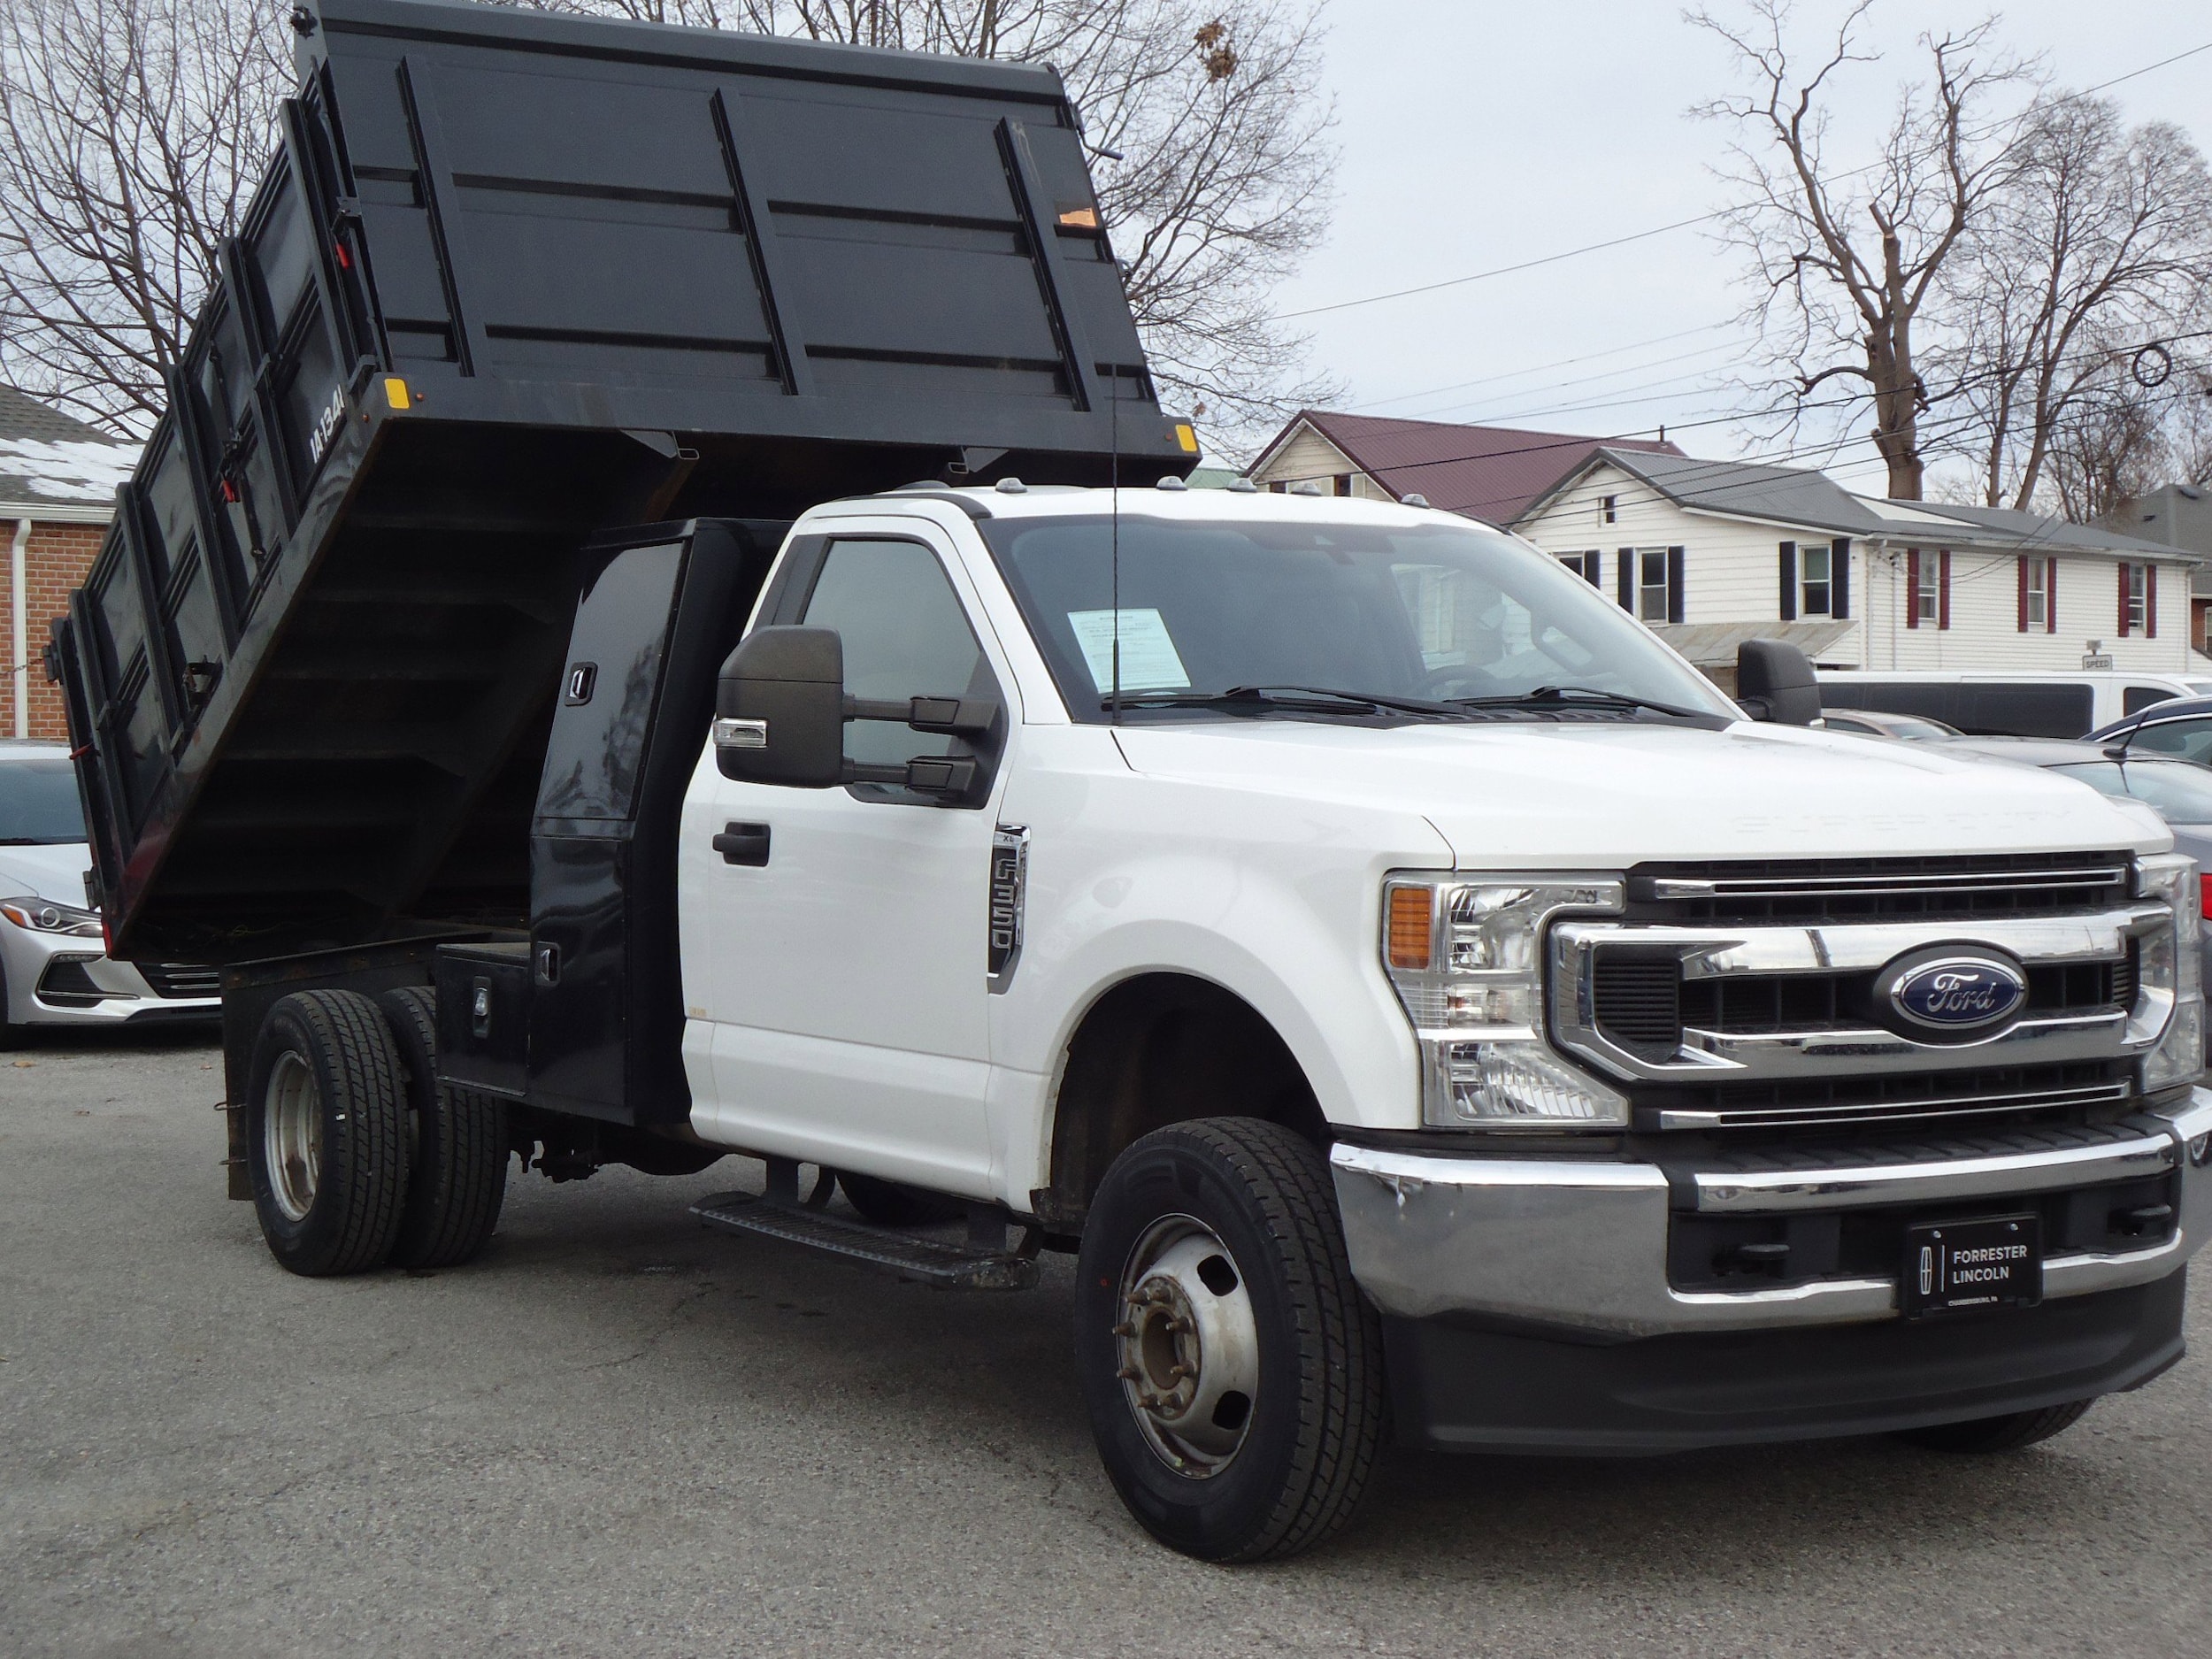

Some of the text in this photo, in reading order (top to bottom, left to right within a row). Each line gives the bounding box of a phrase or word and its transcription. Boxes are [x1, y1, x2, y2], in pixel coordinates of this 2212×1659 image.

[1927, 973, 1996, 1012] Ford
[1953, 1245, 2027, 1264] FORRESTER
[1953, 1266, 2009, 1284] LINCOLN
